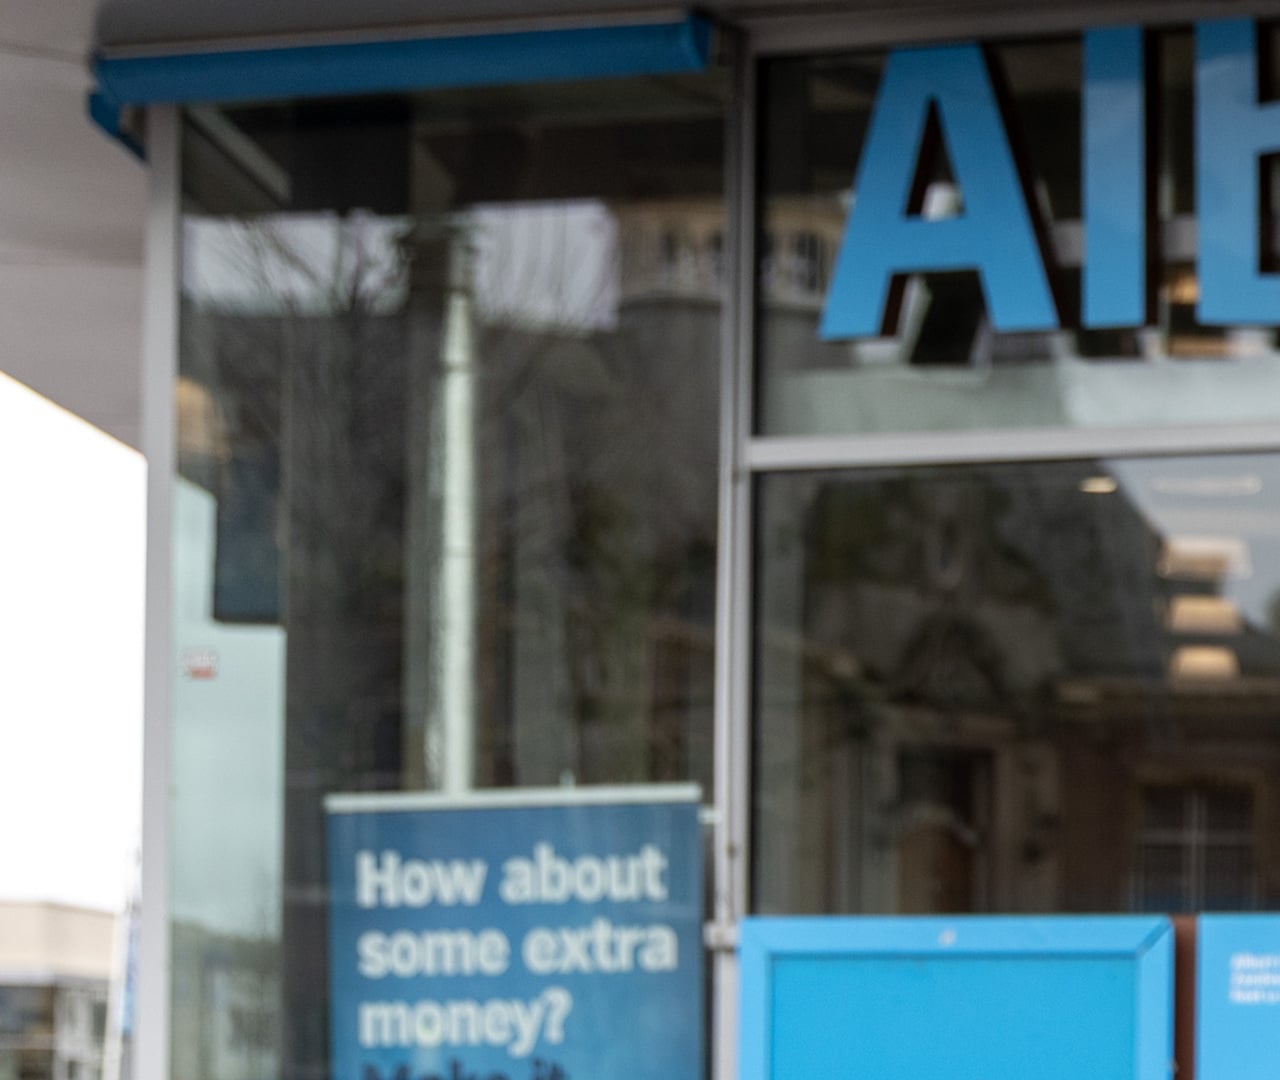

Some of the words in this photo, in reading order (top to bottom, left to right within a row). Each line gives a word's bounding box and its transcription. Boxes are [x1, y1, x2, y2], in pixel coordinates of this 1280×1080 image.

[355, 848, 488, 908] How
[500, 842, 668, 905] about
[356, 929, 512, 979] some
[521, 916, 680, 975] extra
[358, 985, 574, 1059] money?
